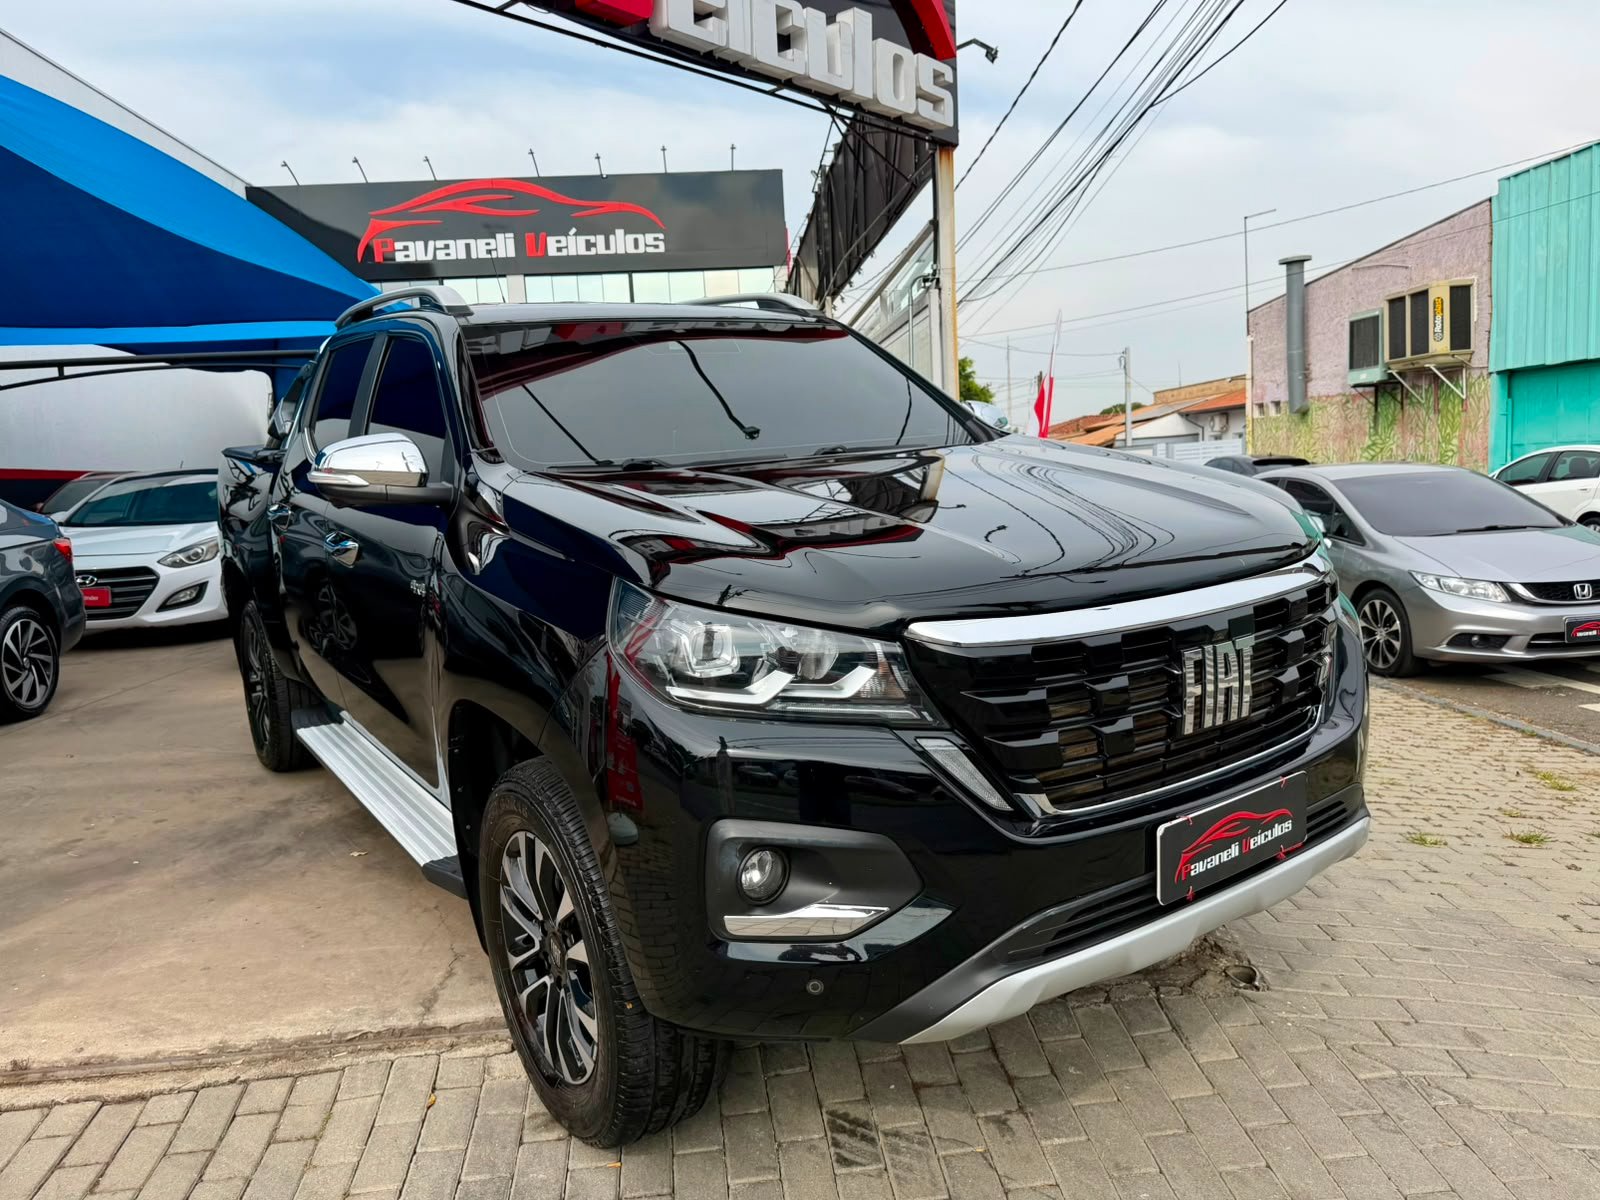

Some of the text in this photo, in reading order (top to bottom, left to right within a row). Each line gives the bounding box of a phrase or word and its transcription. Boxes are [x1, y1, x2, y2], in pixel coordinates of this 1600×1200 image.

[373, 227, 666, 263] Pavaneli Veículos
[1182, 634, 1255, 735] FIAT
[1181, 819, 1292, 881] Pavaneli Veículos
